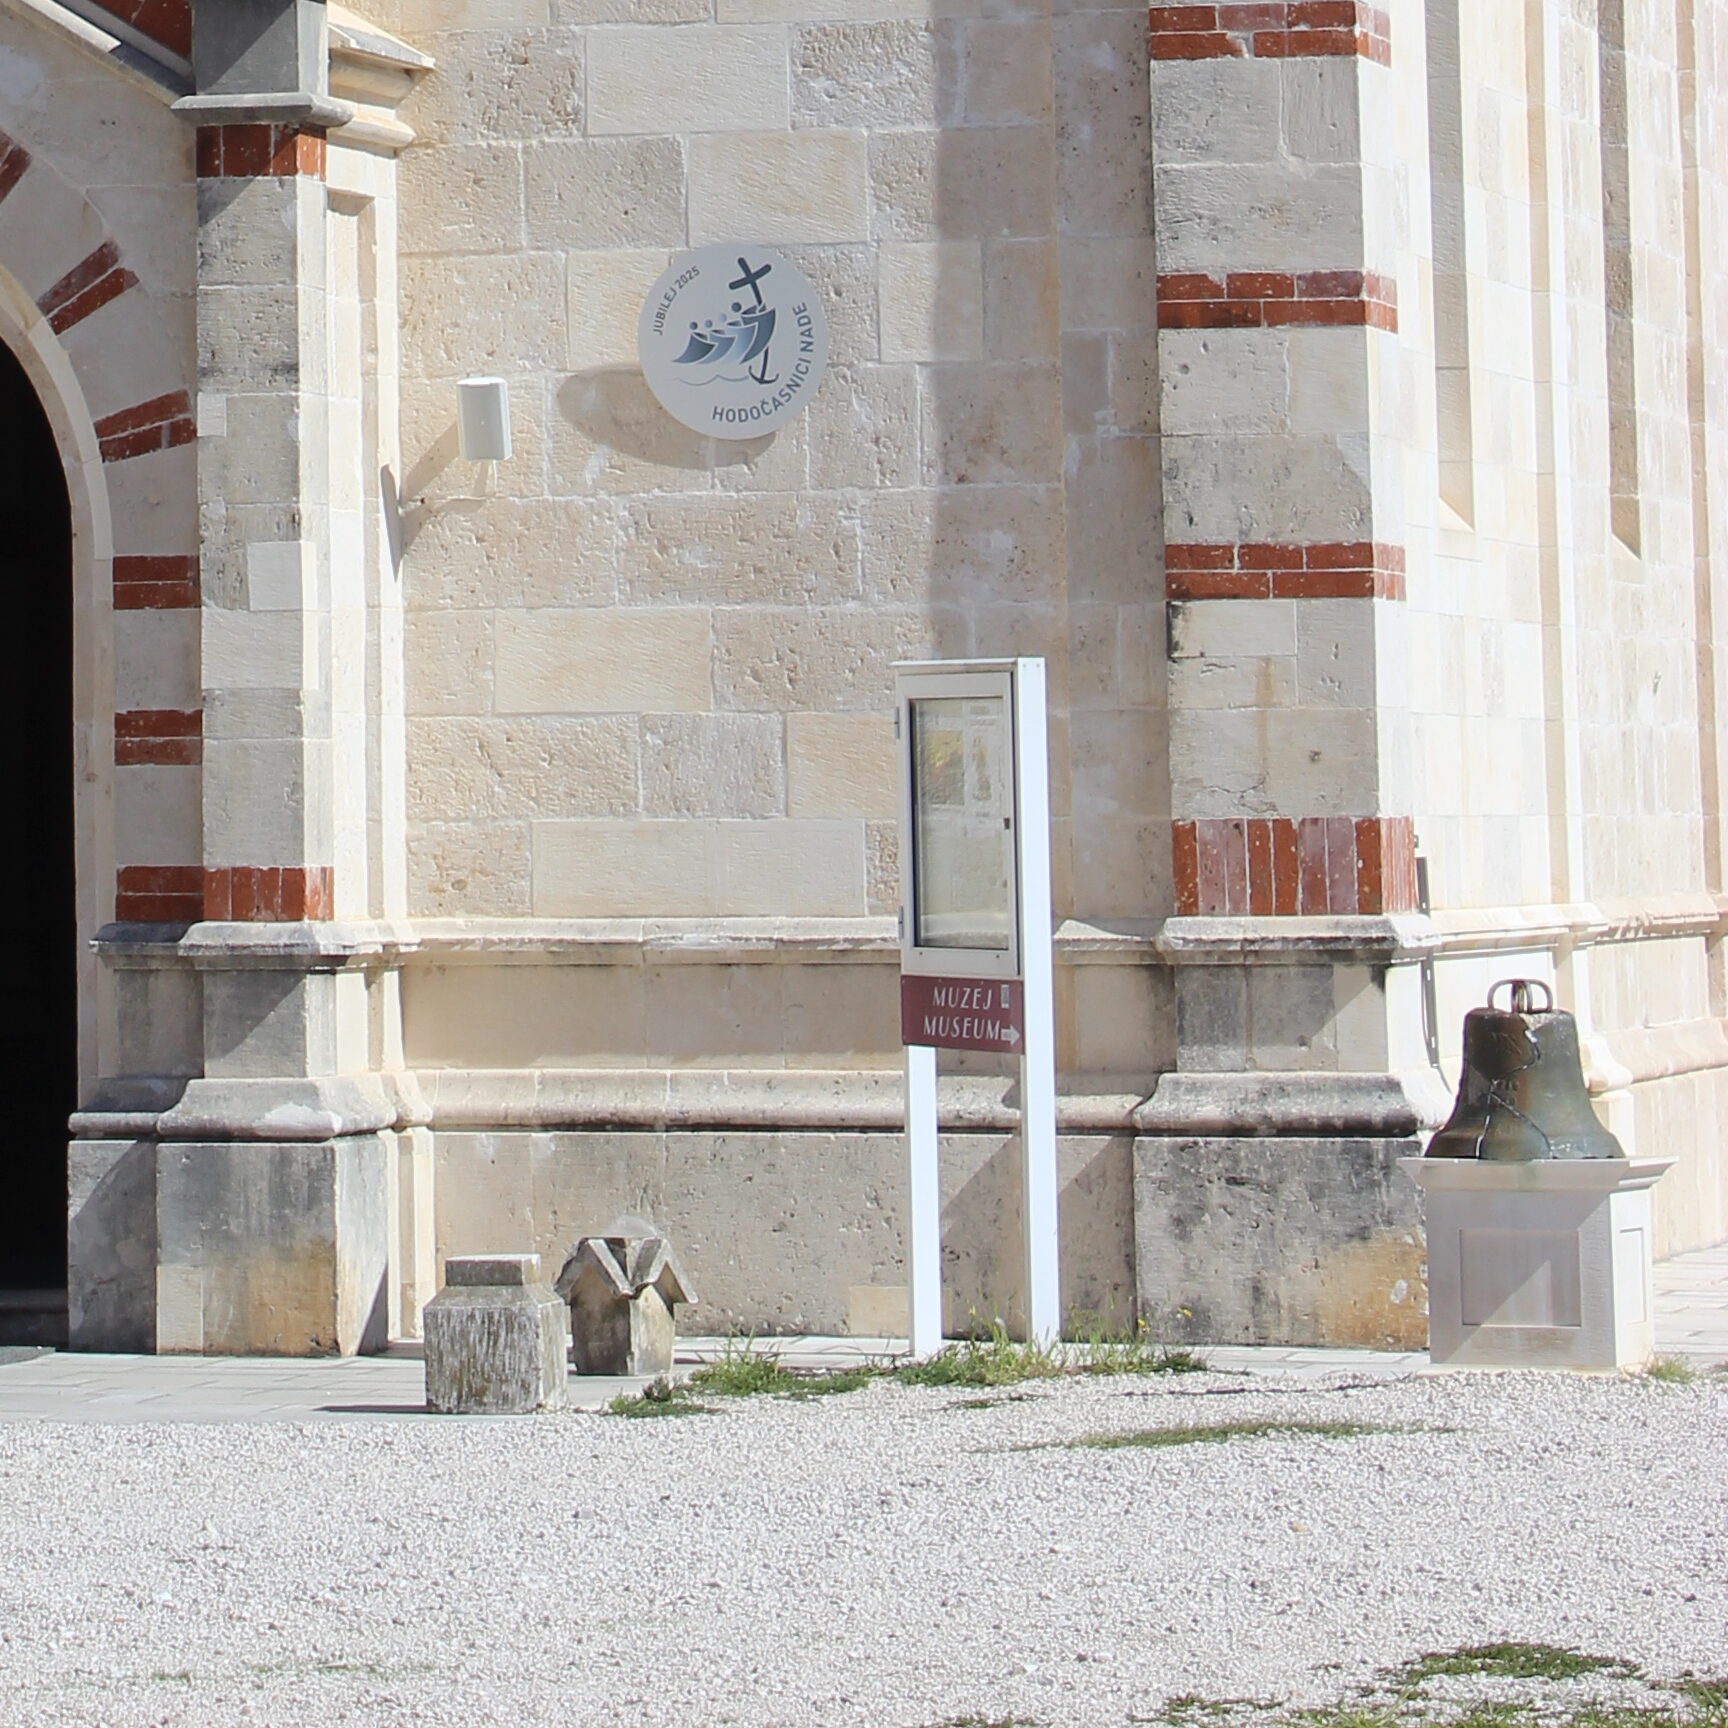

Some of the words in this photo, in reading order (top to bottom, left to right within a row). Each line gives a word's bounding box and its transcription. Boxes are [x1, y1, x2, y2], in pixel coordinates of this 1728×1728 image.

[653, 286, 677, 336] JUBILEJ
[675, 265, 700, 290] 2025
[712, 357, 812, 422] HODOČASNICI
[792, 302, 814, 353] NADE
[932, 986, 992, 1010] MUZEJ
[923, 1015, 1000, 1041] MUSEUM
